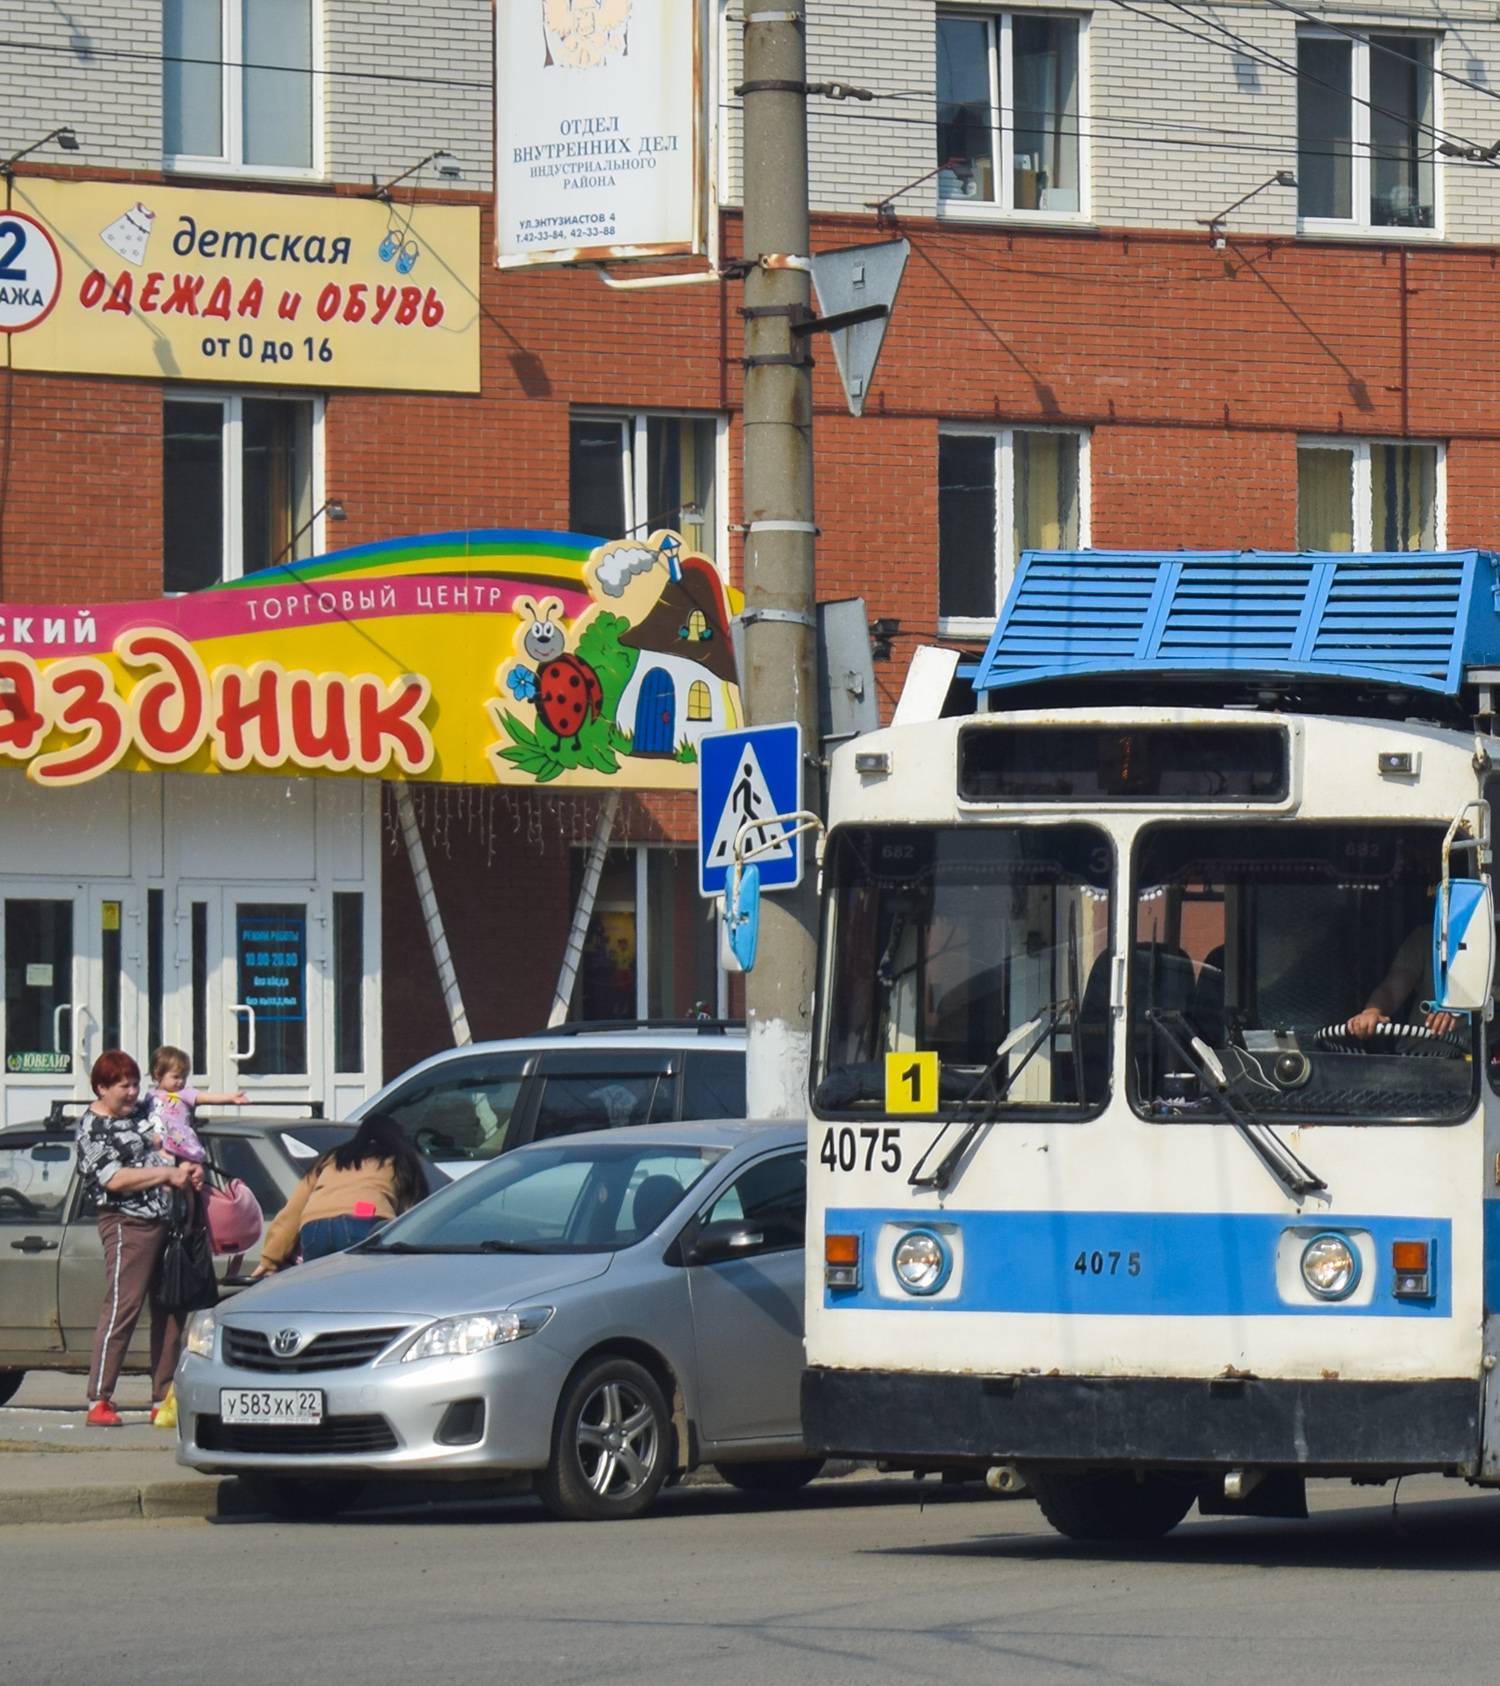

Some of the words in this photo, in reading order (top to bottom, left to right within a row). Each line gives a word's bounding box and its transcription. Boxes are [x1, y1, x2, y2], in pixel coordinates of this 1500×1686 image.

[560, 116, 619, 136] ОТДЕЛ
[513, 137, 632, 163] ВНУТРЕННИХ
[638, 135, 679, 156] ДЕЛ
[530, 157, 657, 178] ИНДУСТРИАЛЬНОГО
[563, 175, 617, 190] РАЙОНА
[519, 213, 606, 230] УЛ.ЭНТУЗИАСТОВ
[609, 212, 616, 222] 4
[172, 216, 352, 264] детская
[80, 271, 264, 321] ОДЕЖДА
[278, 290, 303, 321] и
[316, 281, 446, 328] ОБУВЬ
[201, 337, 231, 357] от
[238, 333, 254, 359] 0
[260, 340, 294, 363] до
[303, 336, 334, 362] 16
[247, 585, 397, 620] ТОРГОВЫЙ
[416, 585, 502, 609] ЦЕНТР
[23, 1052, 71, 1068] ЮВЕЛИР
[902, 1062, 922, 1102] 1
[820, 1127, 902, 1173] 4075
[1074, 1251, 1141, 1276] 4075
[299, 1393, 316, 1410] 22
